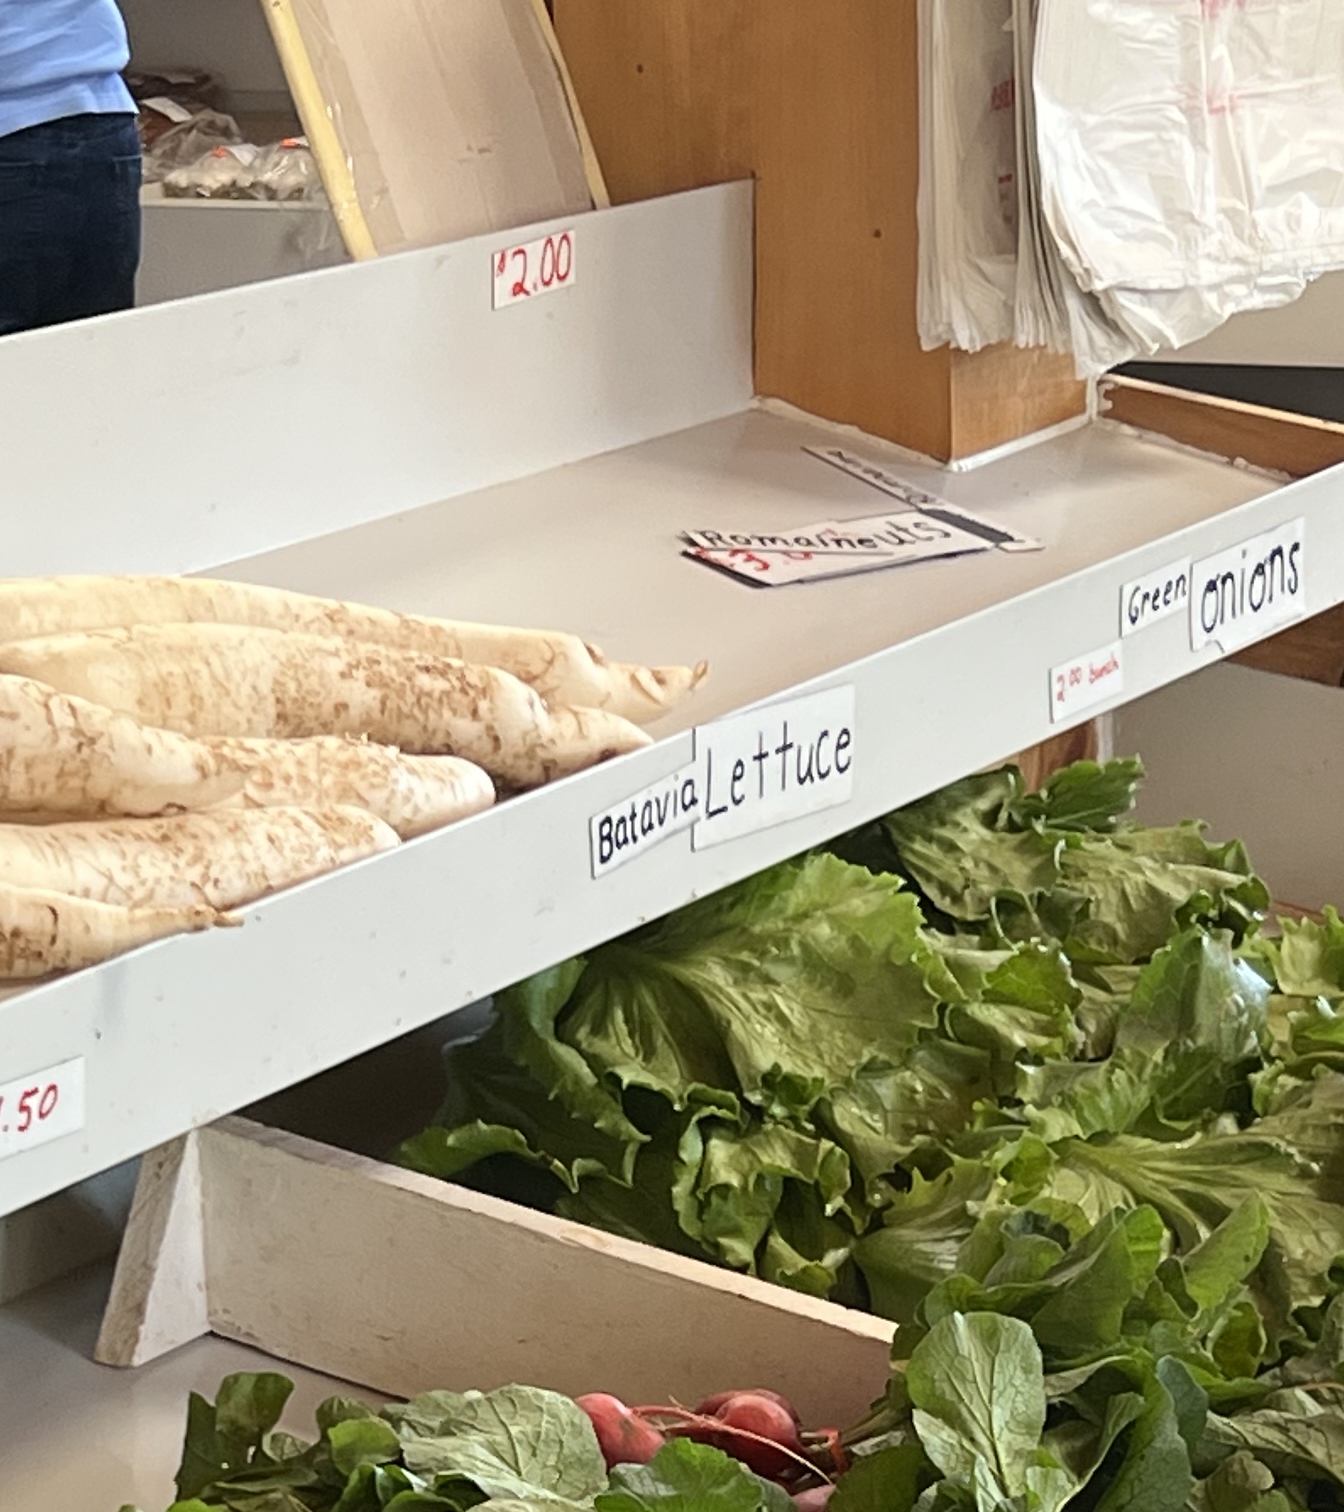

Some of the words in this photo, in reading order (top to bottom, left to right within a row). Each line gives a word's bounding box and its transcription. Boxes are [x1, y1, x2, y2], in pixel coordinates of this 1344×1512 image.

[496, 232, 572, 297] $2.00
[1128, 574, 1186, 625] Green
[598, 774, 698, 864] Batavia
[705, 720, 852, 820] Lettuce
